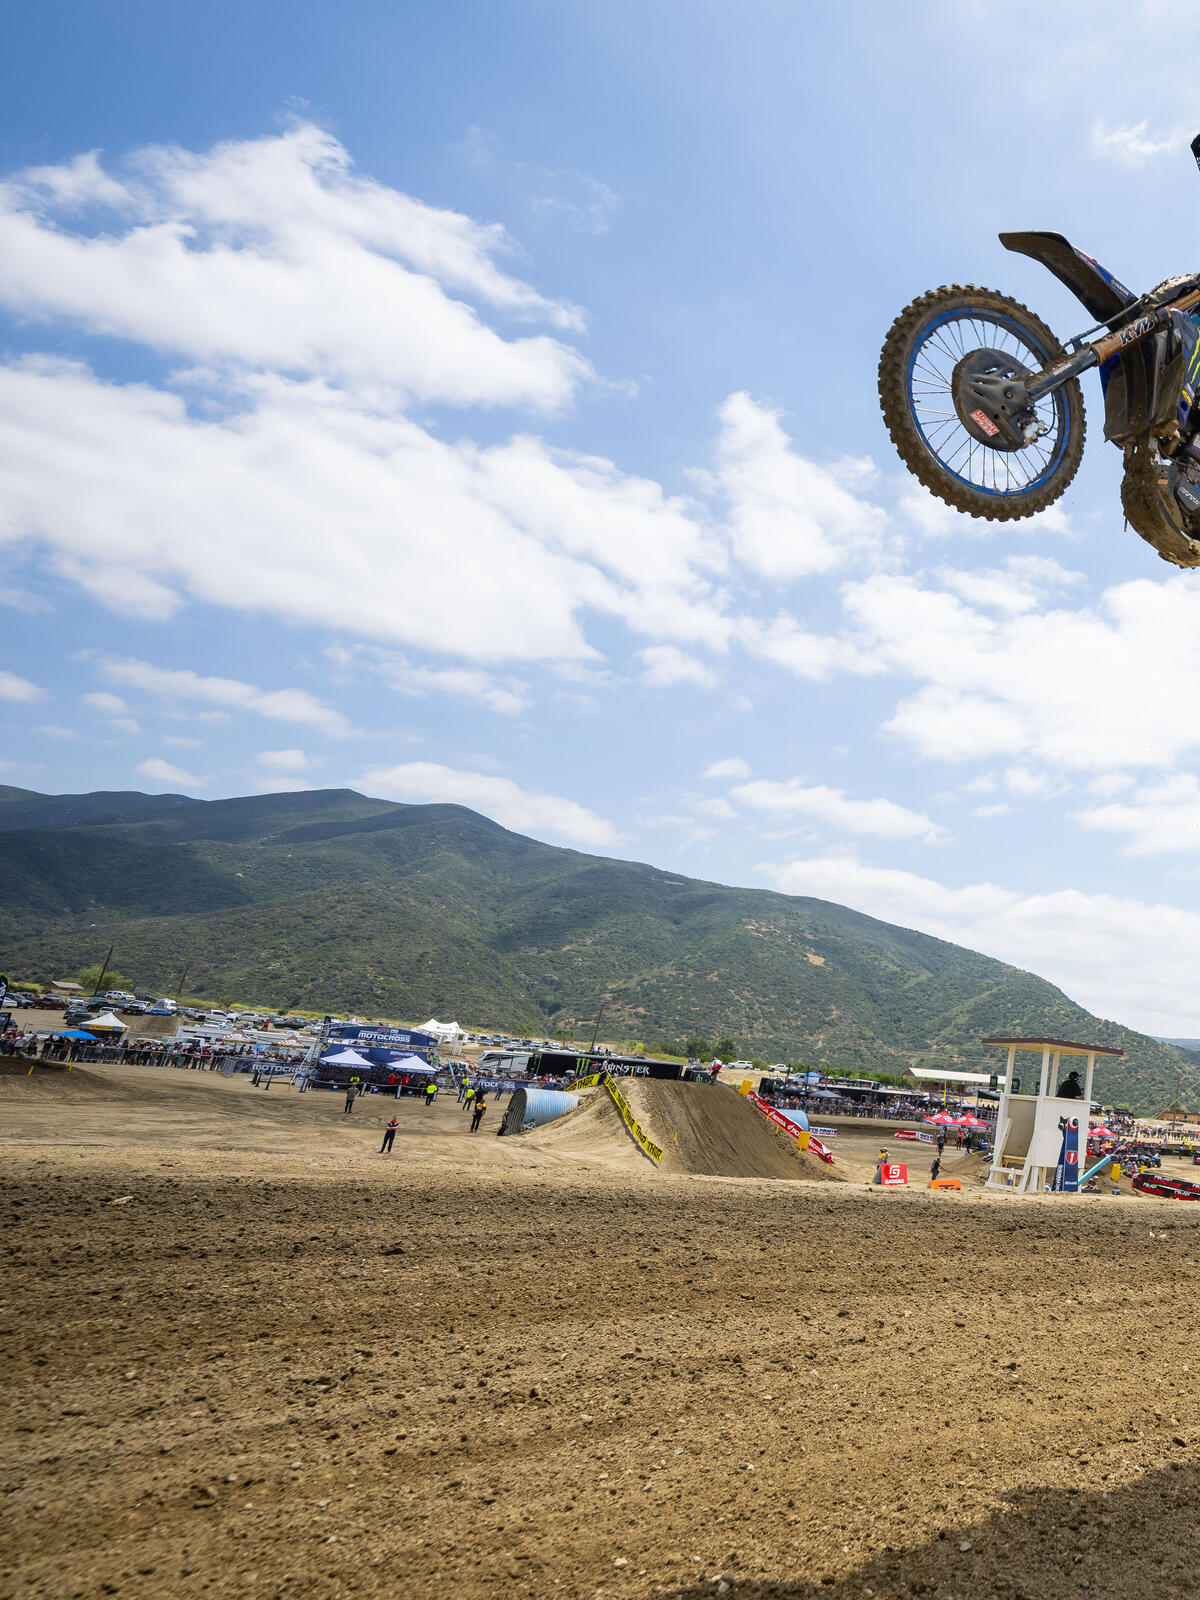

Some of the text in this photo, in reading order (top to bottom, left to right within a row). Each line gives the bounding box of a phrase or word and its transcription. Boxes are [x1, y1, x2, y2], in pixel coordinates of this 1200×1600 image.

[358, 1032, 411, 1043] MOTOCROSS
[252, 1063, 309, 1074] MOTOCROS
[603, 1061, 650, 1075] ONSTER
[577, 1076, 595, 1090] THOR
[772, 1113, 786, 1127] HONDA
[647, 1141, 662, 1160] THOR
